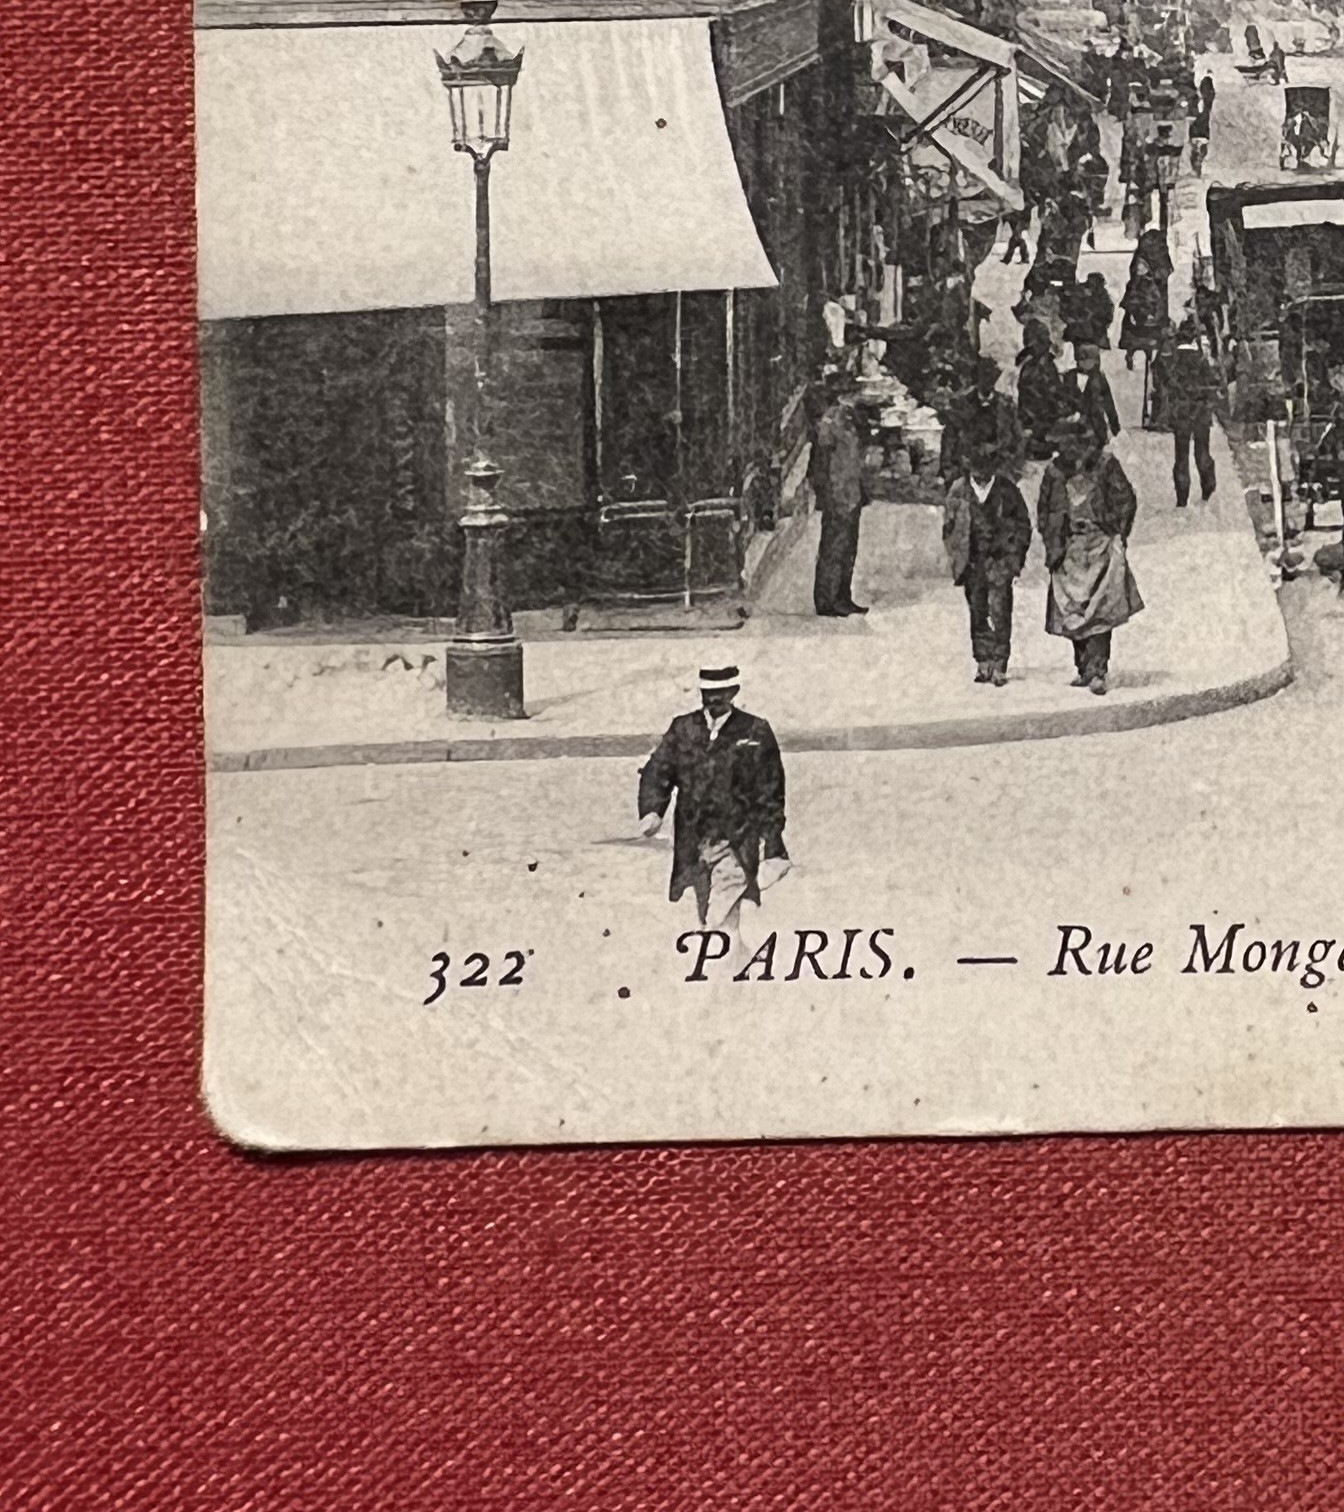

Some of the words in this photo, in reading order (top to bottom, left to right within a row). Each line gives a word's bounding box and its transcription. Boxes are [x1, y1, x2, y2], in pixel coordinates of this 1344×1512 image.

[423, 950, 530, 1006] 322
[675, 927, 916, 984] PARIS.
[1046, 924, 1155, 977] Rue
